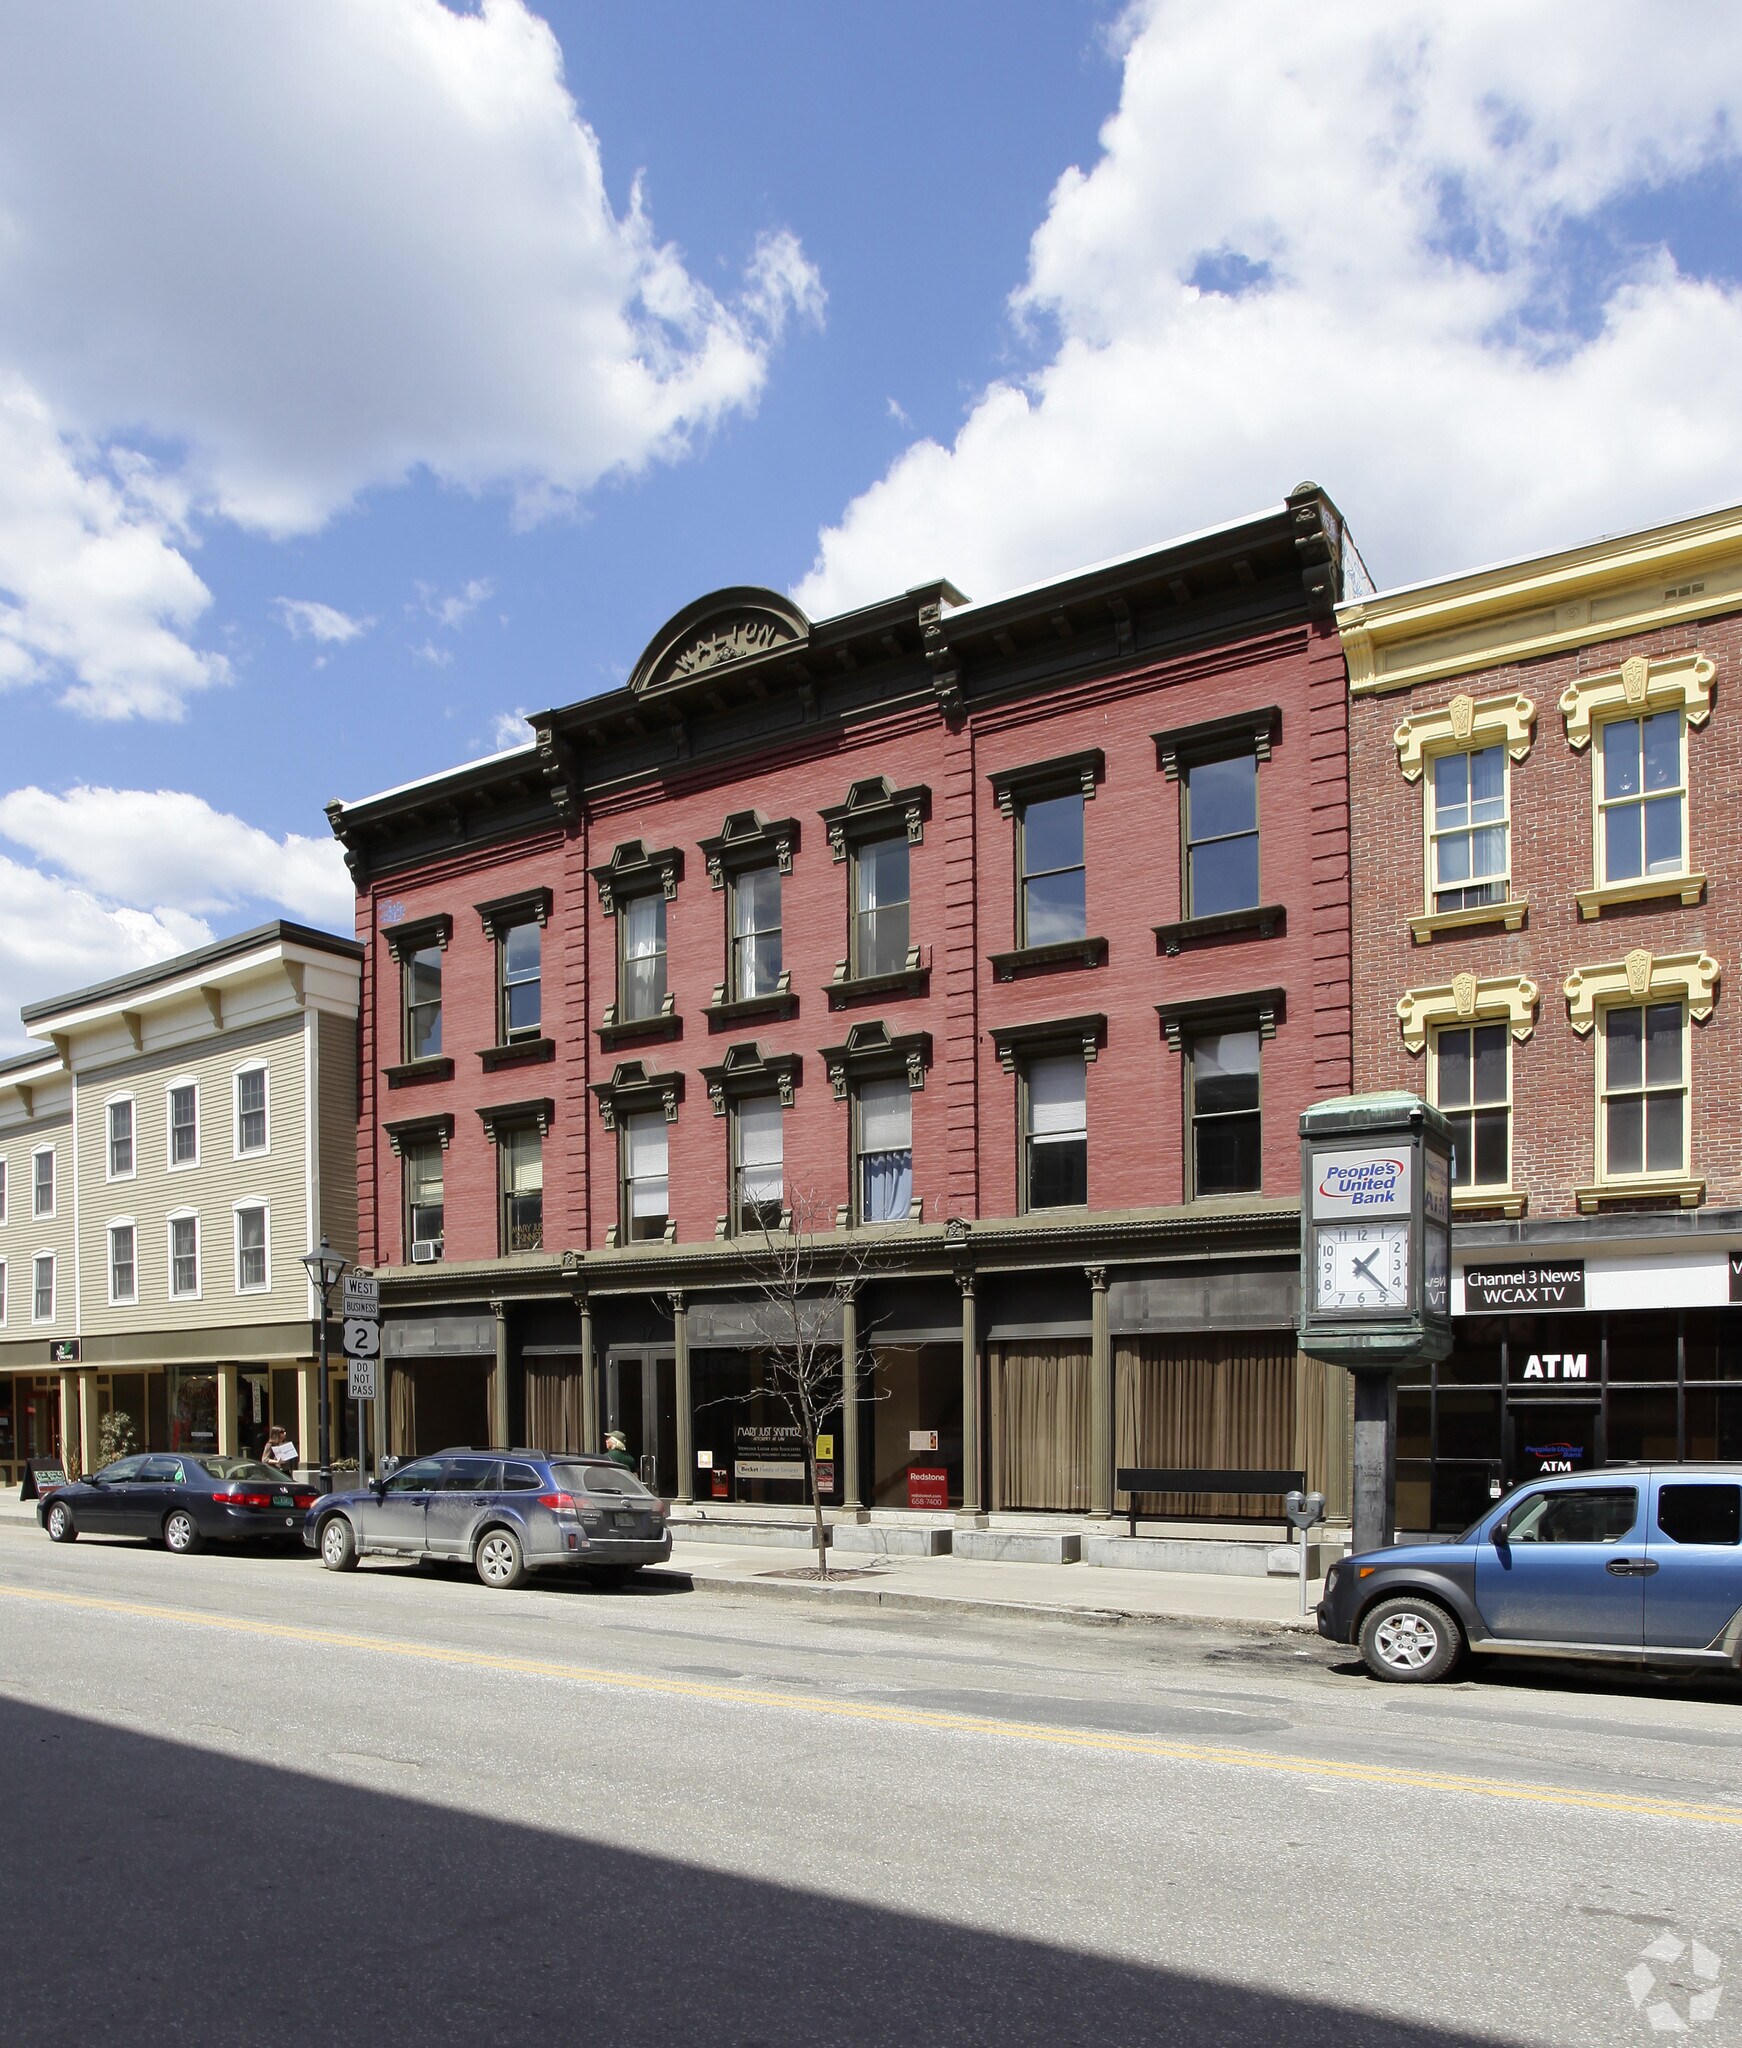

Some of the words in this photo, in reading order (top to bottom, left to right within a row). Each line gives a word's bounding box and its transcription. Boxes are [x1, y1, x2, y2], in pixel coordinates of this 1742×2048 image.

[675, 621, 775, 672] WALTON
[1327, 1163, 1395, 1180] People's
[1339, 1176, 1396, 1192] United
[1352, 1190, 1396, 1205] Bank
[1339, 1230, 1347, 1242] 11
[1357, 1229, 1368, 1241] 12
[1323, 1245, 1334, 1257] 10
[1393, 1241, 1401, 1253] 2
[1324, 1262, 1332, 1274] 9
[1393, 1259, 1401, 1271] 3
[1392, 1276, 1402, 1288] 4
[1467, 1269, 1526, 1287] Channel
[1528, 1270, 1537, 1285] 3
[1540, 1269, 1581, 1284] News
[349, 1279, 374, 1294] WEST
[1324, 1279, 1332, 1291] 8
[1338, 1293, 1346, 1304] 7
[1357, 1292, 1366, 1303] 6
[1379, 1291, 1387, 1303] 5
[1483, 1287, 1538, 1304] WCAX
[1540, 1286, 1565, 1301] TV
[346, 1301, 377, 1314] BUSINESS
[355, 1328, 368, 1349] 2
[357, 1362, 368, 1372] DO
[1523, 1354, 1587, 1379] ATM
[354, 1373, 370, 1384] NOT
[352, 1385, 373, 1396] PASS
[737, 1426, 758, 1437] MARY
[759, 1426, 772, 1437] JUST
[773, 1426, 802, 1438] SKINNER
[1525, 1445, 1557, 1453] People's
[1556, 1445, 1584, 1453] United
[1540, 1461, 1572, 1472] ATM
[910, 1472, 945, 1481] Redstone
